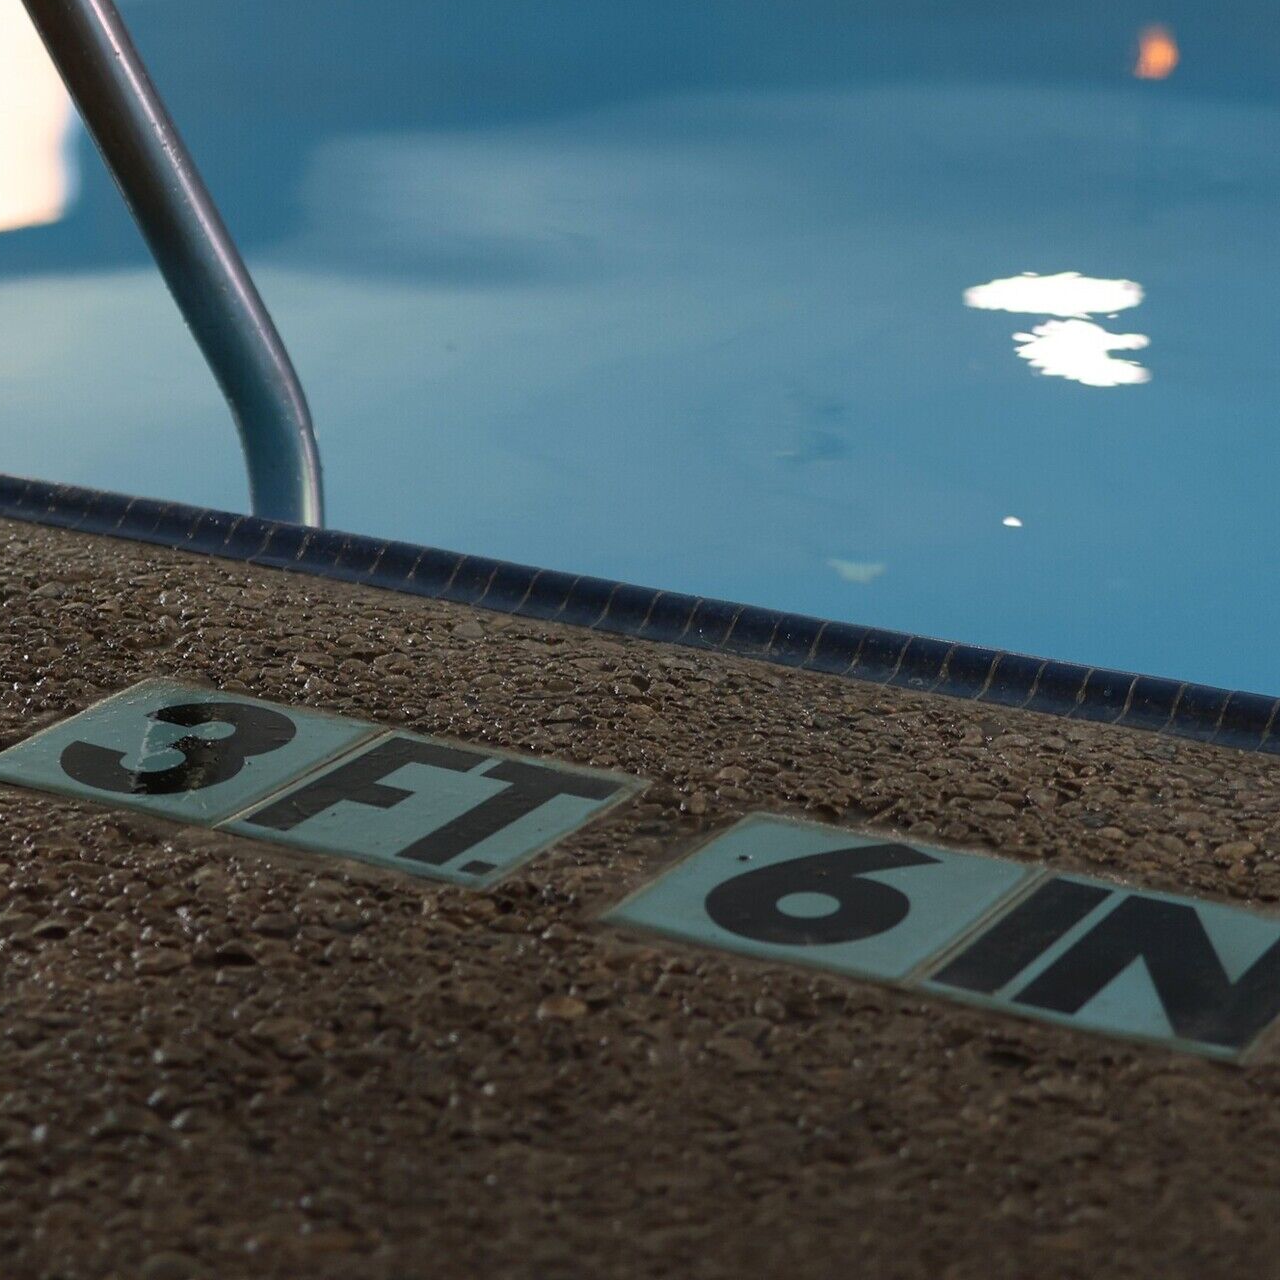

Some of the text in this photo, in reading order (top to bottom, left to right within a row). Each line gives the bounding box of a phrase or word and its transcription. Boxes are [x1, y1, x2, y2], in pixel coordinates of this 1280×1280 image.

[60, 702, 297, 795] 3
[246, 736, 626, 876] FT.
[704, 843, 944, 947] 6
